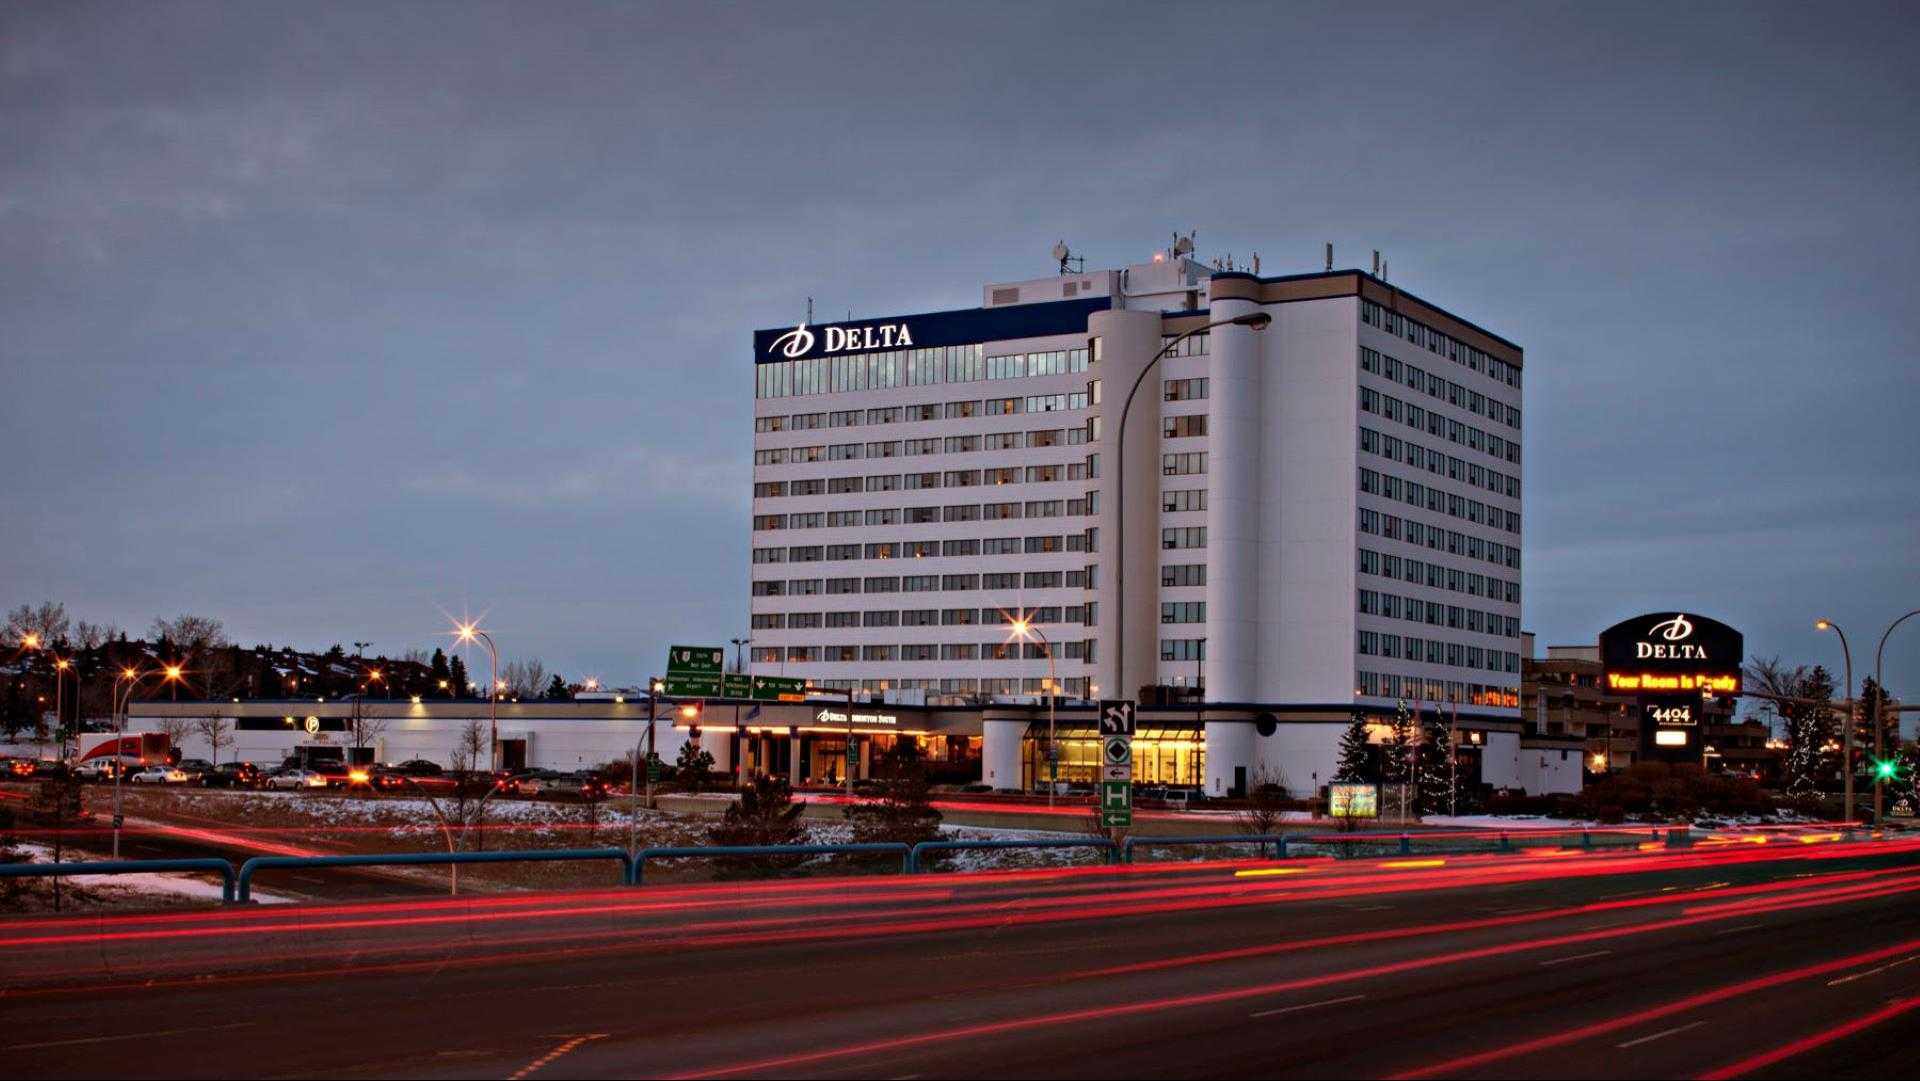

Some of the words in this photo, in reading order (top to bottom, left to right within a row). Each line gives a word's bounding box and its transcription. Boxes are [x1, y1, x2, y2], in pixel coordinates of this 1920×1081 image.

[824, 324, 913, 352] DELTA
[1636, 642, 1708, 659] DELTA
[1608, 674, 1640, 688] Your
[1641, 674, 1679, 688] Room
[1652, 708, 1690, 721] 4404
[1106, 785, 1127, 806] H
